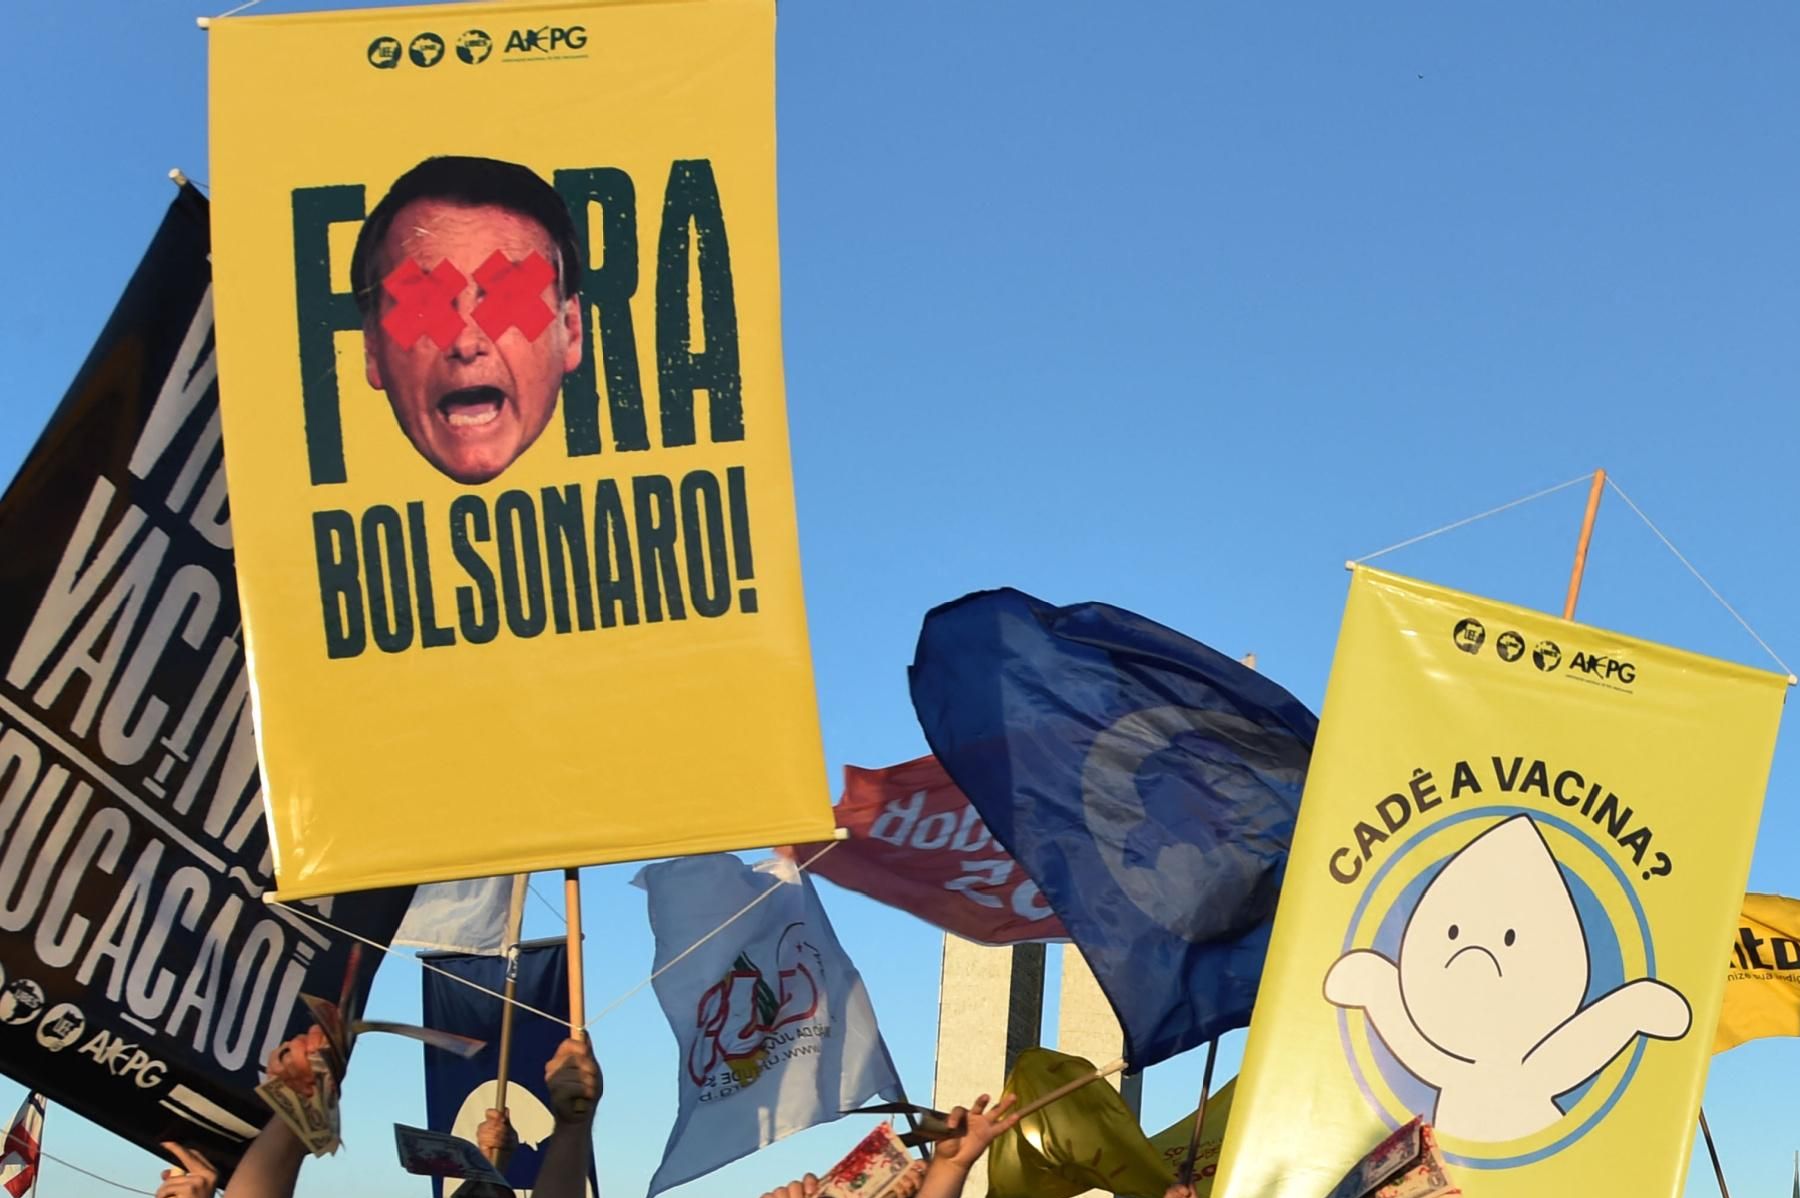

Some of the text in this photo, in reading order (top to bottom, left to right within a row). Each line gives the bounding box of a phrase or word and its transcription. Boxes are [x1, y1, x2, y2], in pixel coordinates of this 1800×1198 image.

[290, 158, 745, 487] FRA
[311, 465, 760, 661] BOLSONARO!
[1327, 755, 1673, 885] CADÊ A VACINA?
